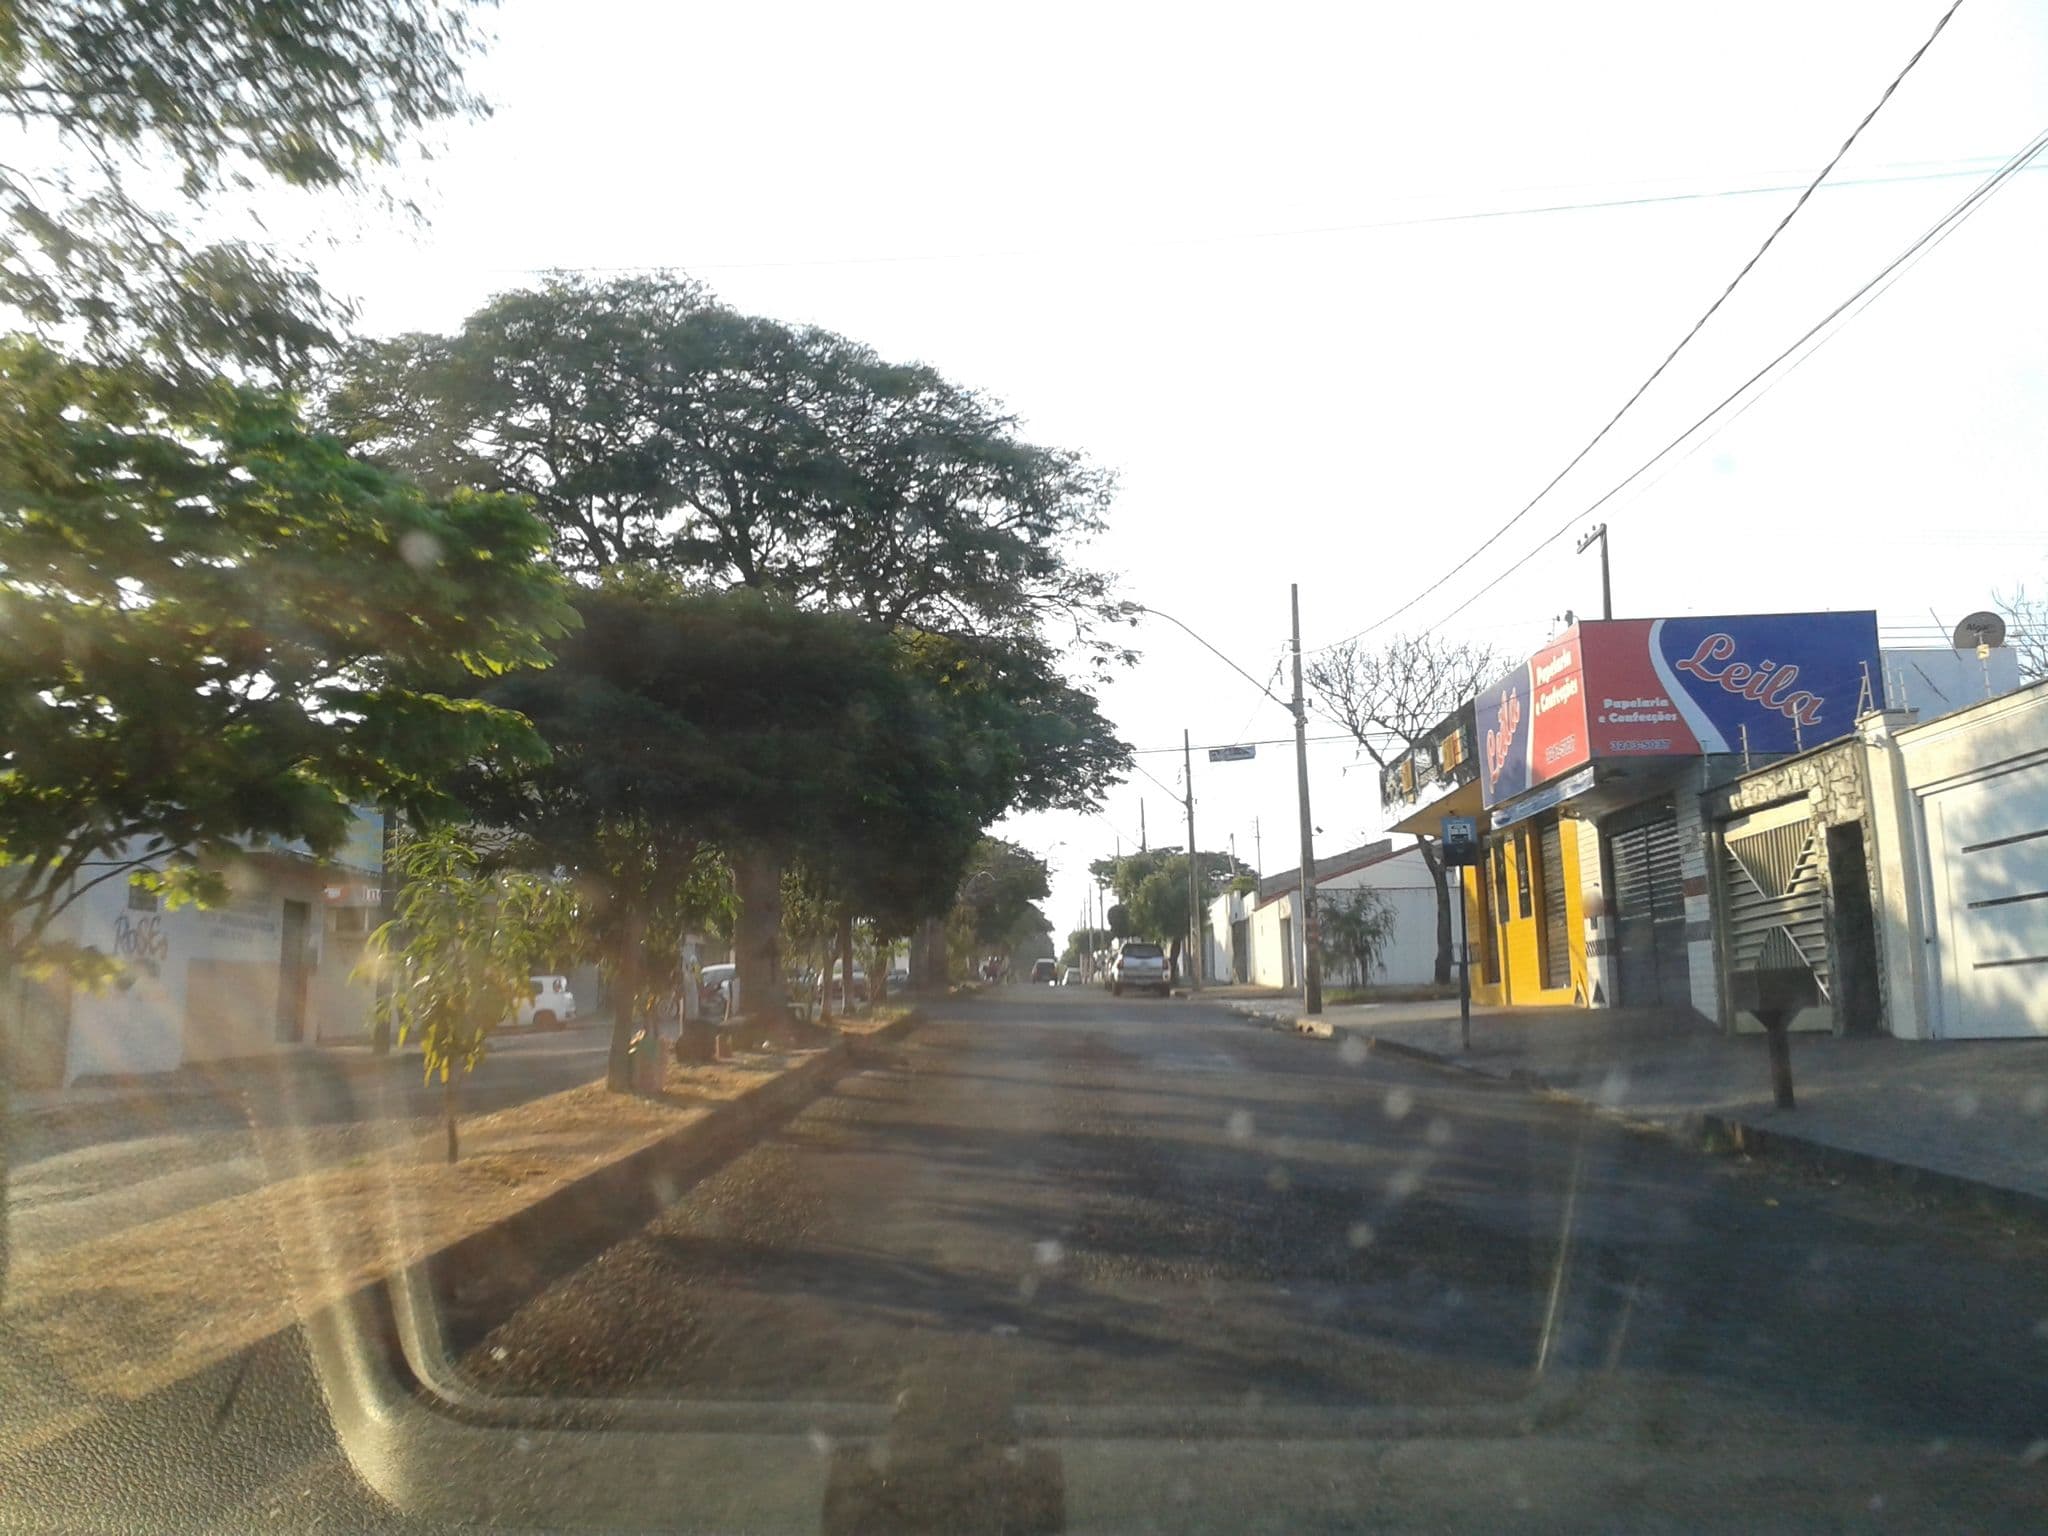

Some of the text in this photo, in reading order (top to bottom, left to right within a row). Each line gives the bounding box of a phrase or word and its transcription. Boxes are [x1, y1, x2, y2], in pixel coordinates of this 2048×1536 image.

[1536, 649, 1572, 686] Papelaria
[1675, 633, 1824, 725] Leila
[1598, 711, 1677, 724] e Confecções
[1603, 697, 1669, 710] Papelaria
[1487, 687, 1520, 794] Leila
